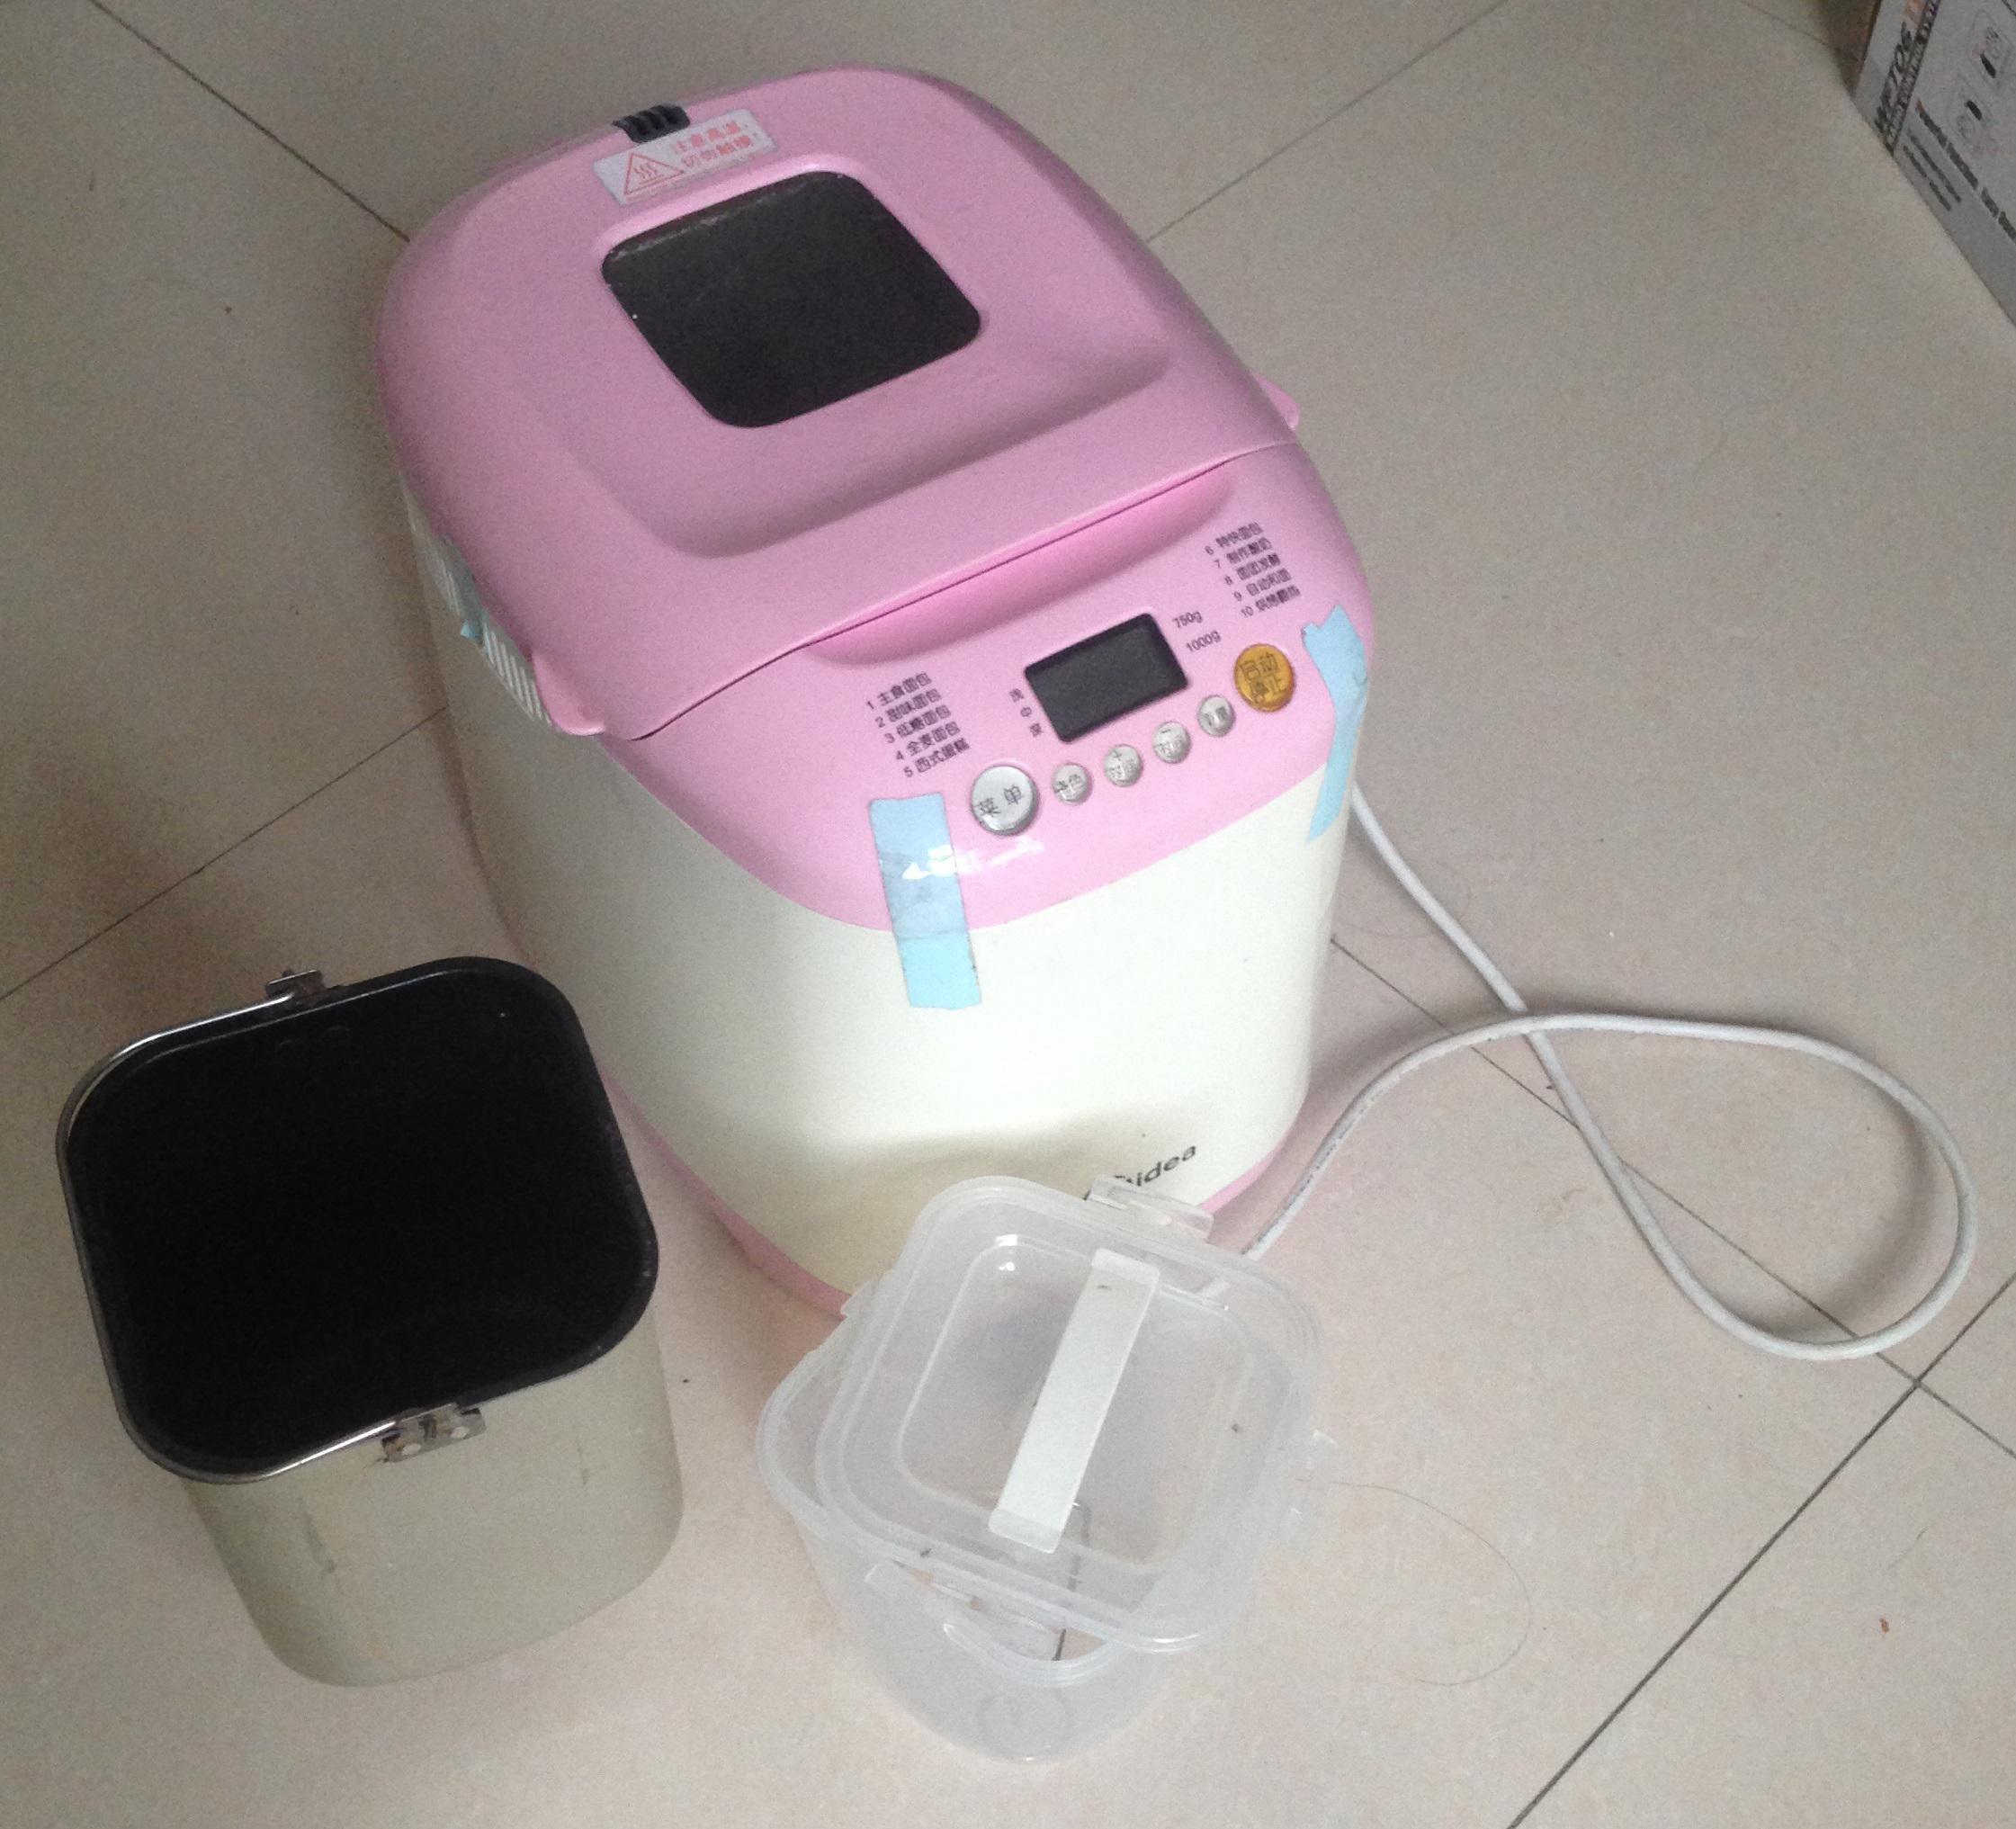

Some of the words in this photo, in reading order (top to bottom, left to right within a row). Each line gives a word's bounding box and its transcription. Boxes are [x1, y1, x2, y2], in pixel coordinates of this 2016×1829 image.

[1205, 545, 1214, 555] 6
[1214, 559, 1221, 569] 7
[1224, 575, 1233, 586] 8
[1233, 591, 1242, 602] 9
[1241, 605, 1254, 618] 10
[1172, 611, 1203, 628] 750g
[1186, 630, 1222, 652] 1000g
[866, 700, 874, 710] 1
[877, 672, 932, 706] 主食面包
[1020, 706, 1032, 718] 中
[875, 716, 885, 728] 2
[884, 732, 895, 743] 3
[896, 704, 952, 738] 低糖面包
[895, 750, 905, 760] 4
[906, 722, 961, 756] 全麦面包
[903, 766, 913, 777] 5
[915, 738, 971, 773] 西式蛋糕
[974, 784, 1024, 817] 菜单
